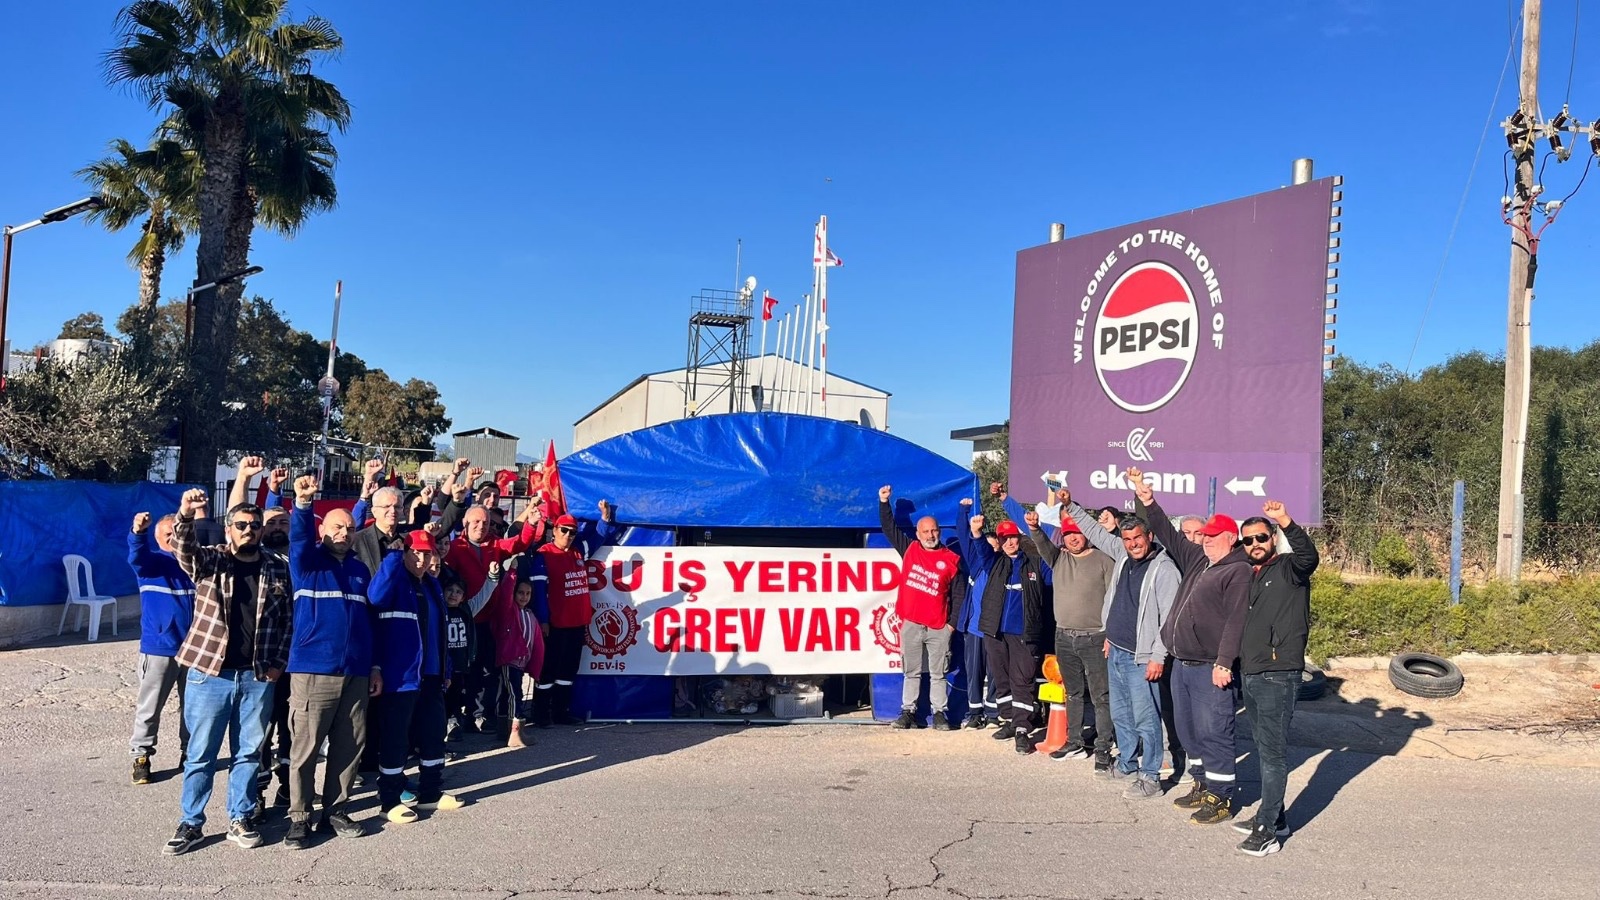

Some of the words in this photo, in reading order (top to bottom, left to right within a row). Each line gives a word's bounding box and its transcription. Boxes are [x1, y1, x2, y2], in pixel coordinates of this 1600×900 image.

[1074, 250, 1118, 364] WELCOME
[1118, 232, 1144, 254] TO
[1148, 229, 1186, 250] THE
[1184, 241, 1223, 307] HOME
[1212, 312, 1225, 350] OF
[1099, 317, 1191, 356] PEPSI
[325, 378, 334, 394] DUR
[1090, 464, 1196, 494] ekam
[584, 559, 643, 593] BU
[663, 552, 707, 602] İŞ
[723, 553, 902, 593] YERİND
[448, 622, 467, 642] 02
[654, 607, 766, 653] GREV
[778, 607, 861, 653] VAR
[590, 660, 625, 672] DEV-İŞ
